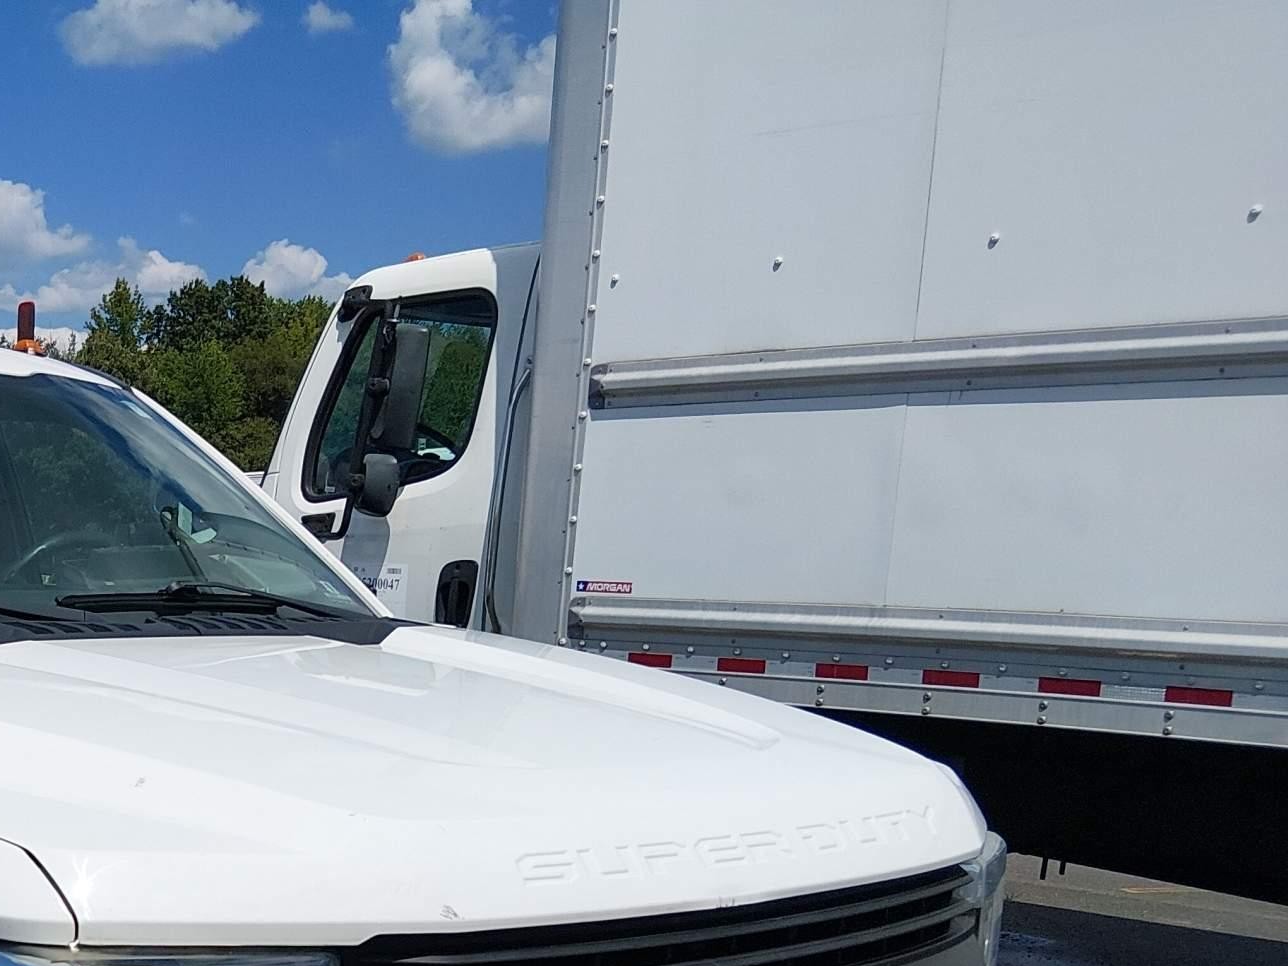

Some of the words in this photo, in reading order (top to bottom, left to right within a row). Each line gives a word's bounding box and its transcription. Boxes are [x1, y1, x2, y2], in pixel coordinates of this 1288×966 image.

[585, 582, 631, 593] MORGAN
[515, 829, 792, 887] SUPER
[795, 805, 940, 855] DUTY
